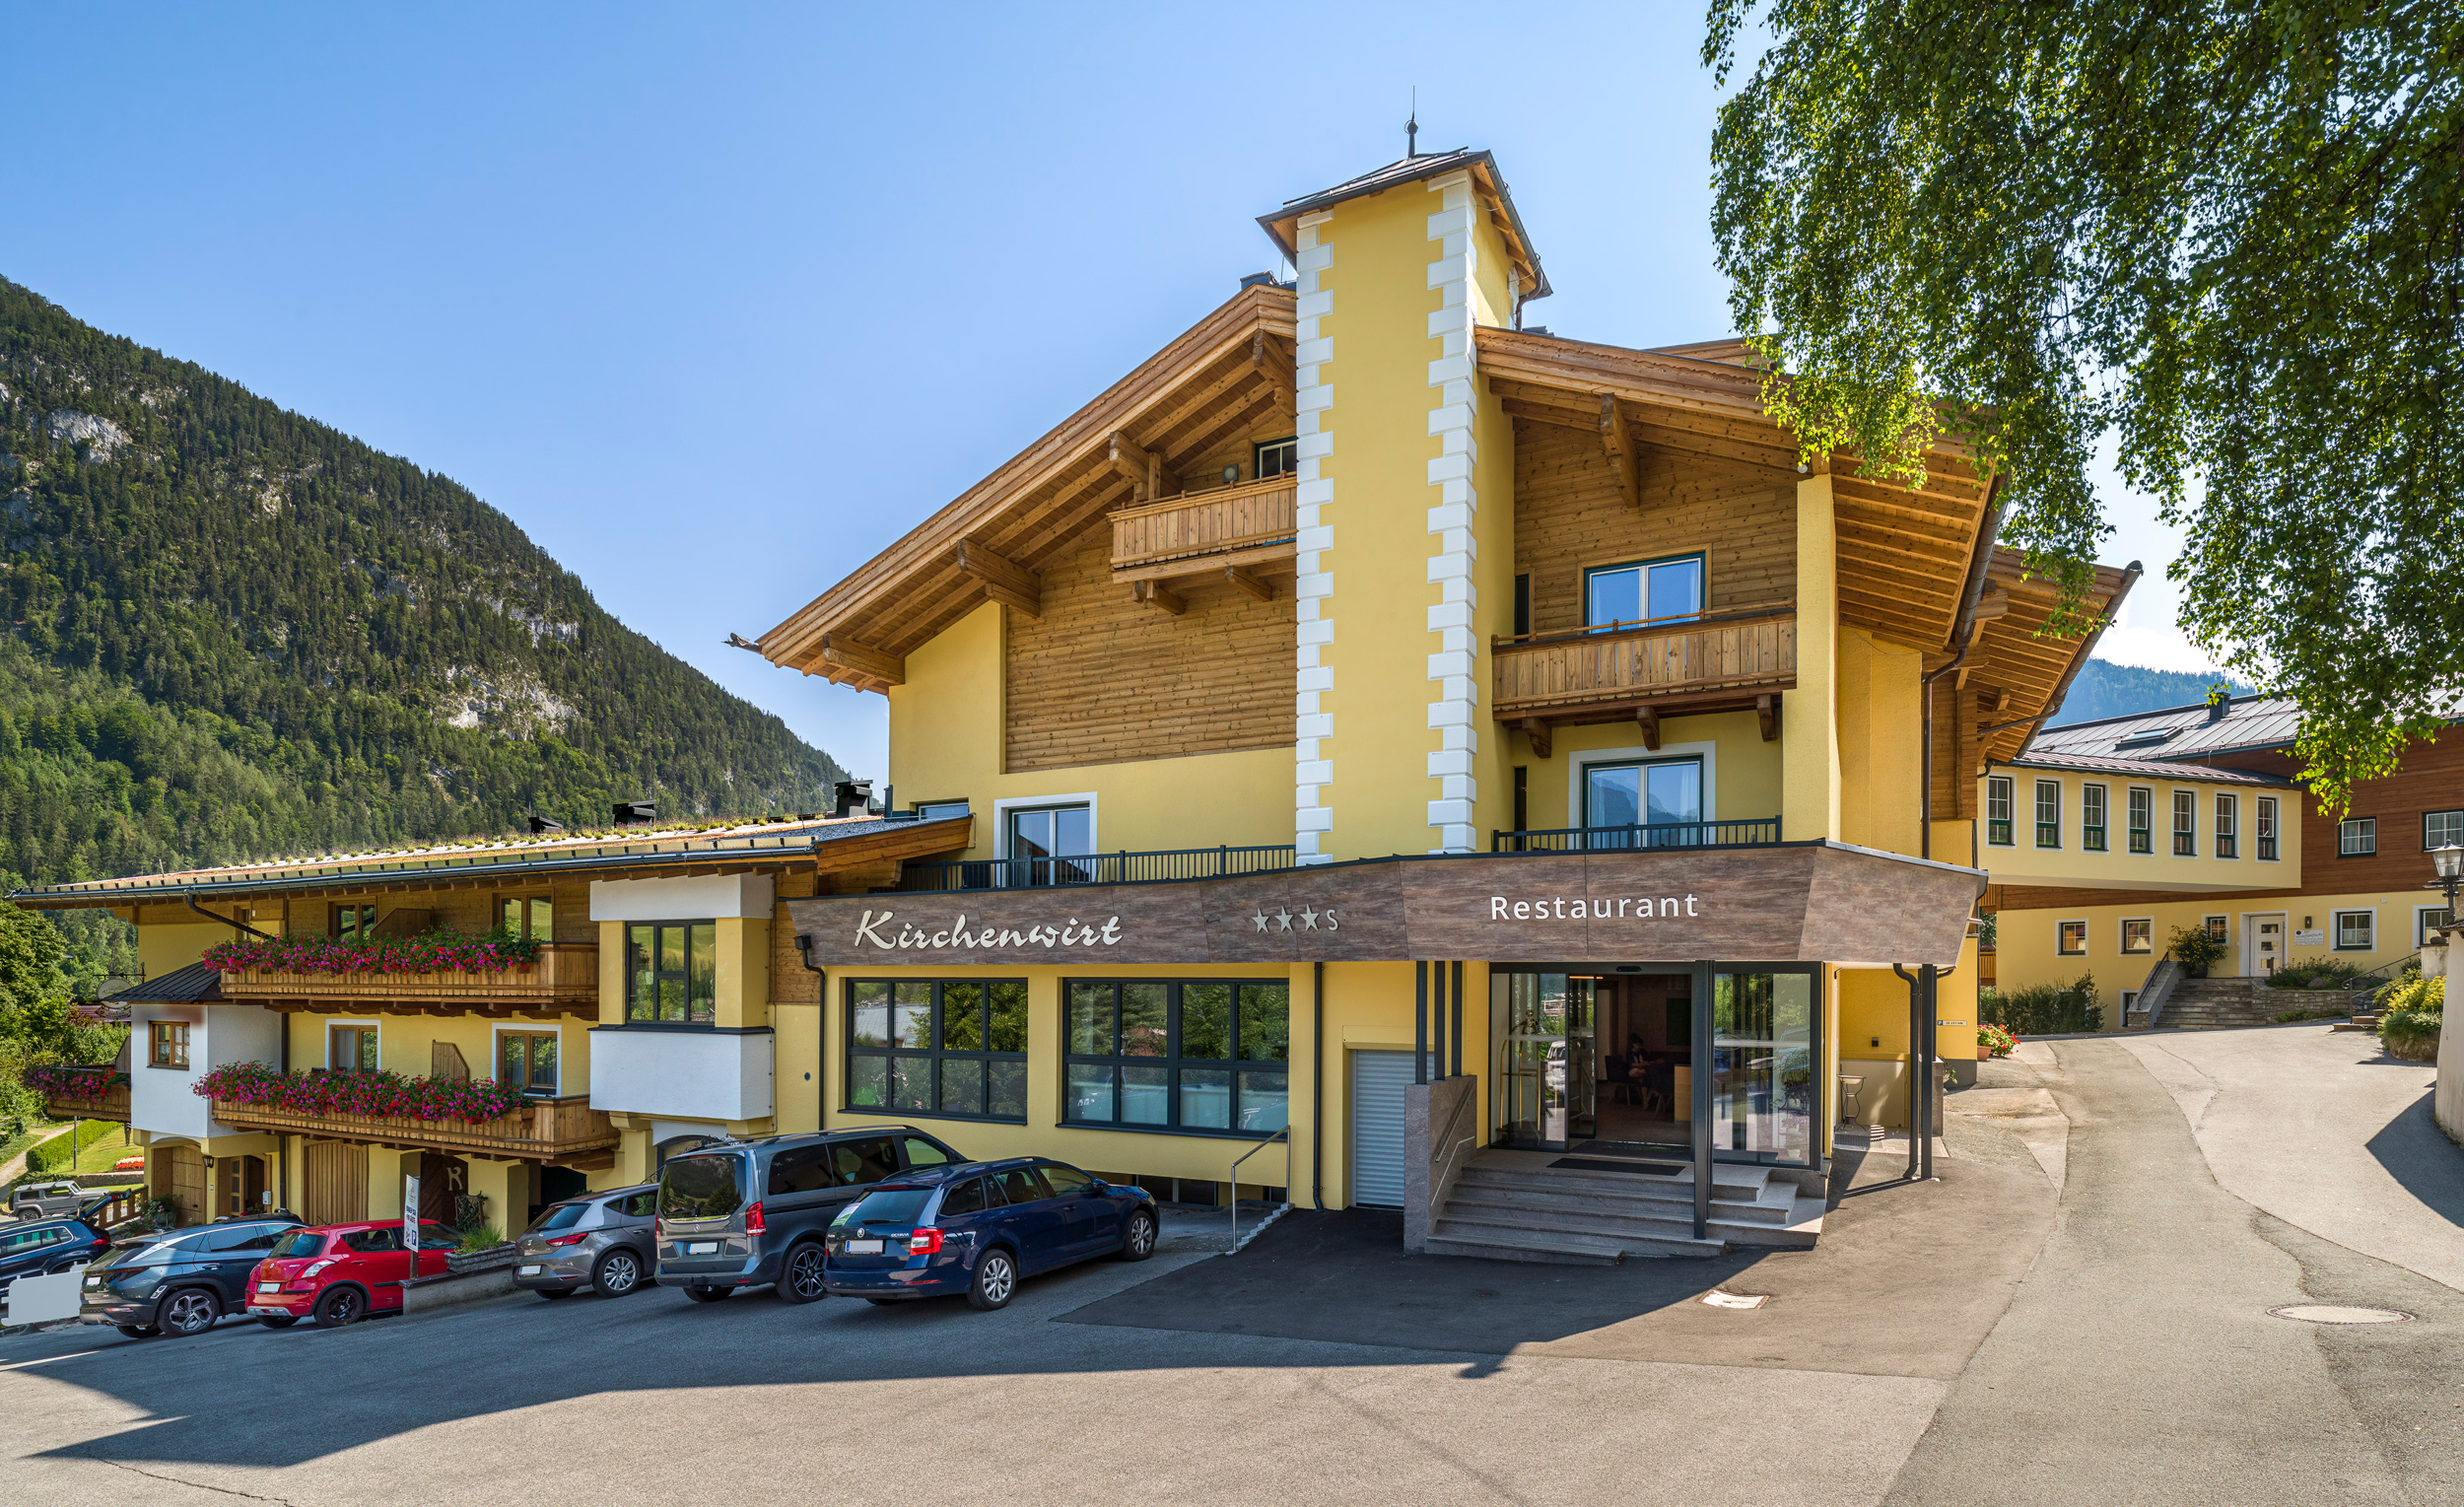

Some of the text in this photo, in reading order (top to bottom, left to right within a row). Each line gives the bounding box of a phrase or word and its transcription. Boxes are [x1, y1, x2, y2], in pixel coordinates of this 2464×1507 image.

[1327, 909, 1338, 931] S
[1490, 893, 1698, 921] Restaurant
[855, 910, 1123, 949] Kirchenwirt
[446, 1166, 462, 1191] R
